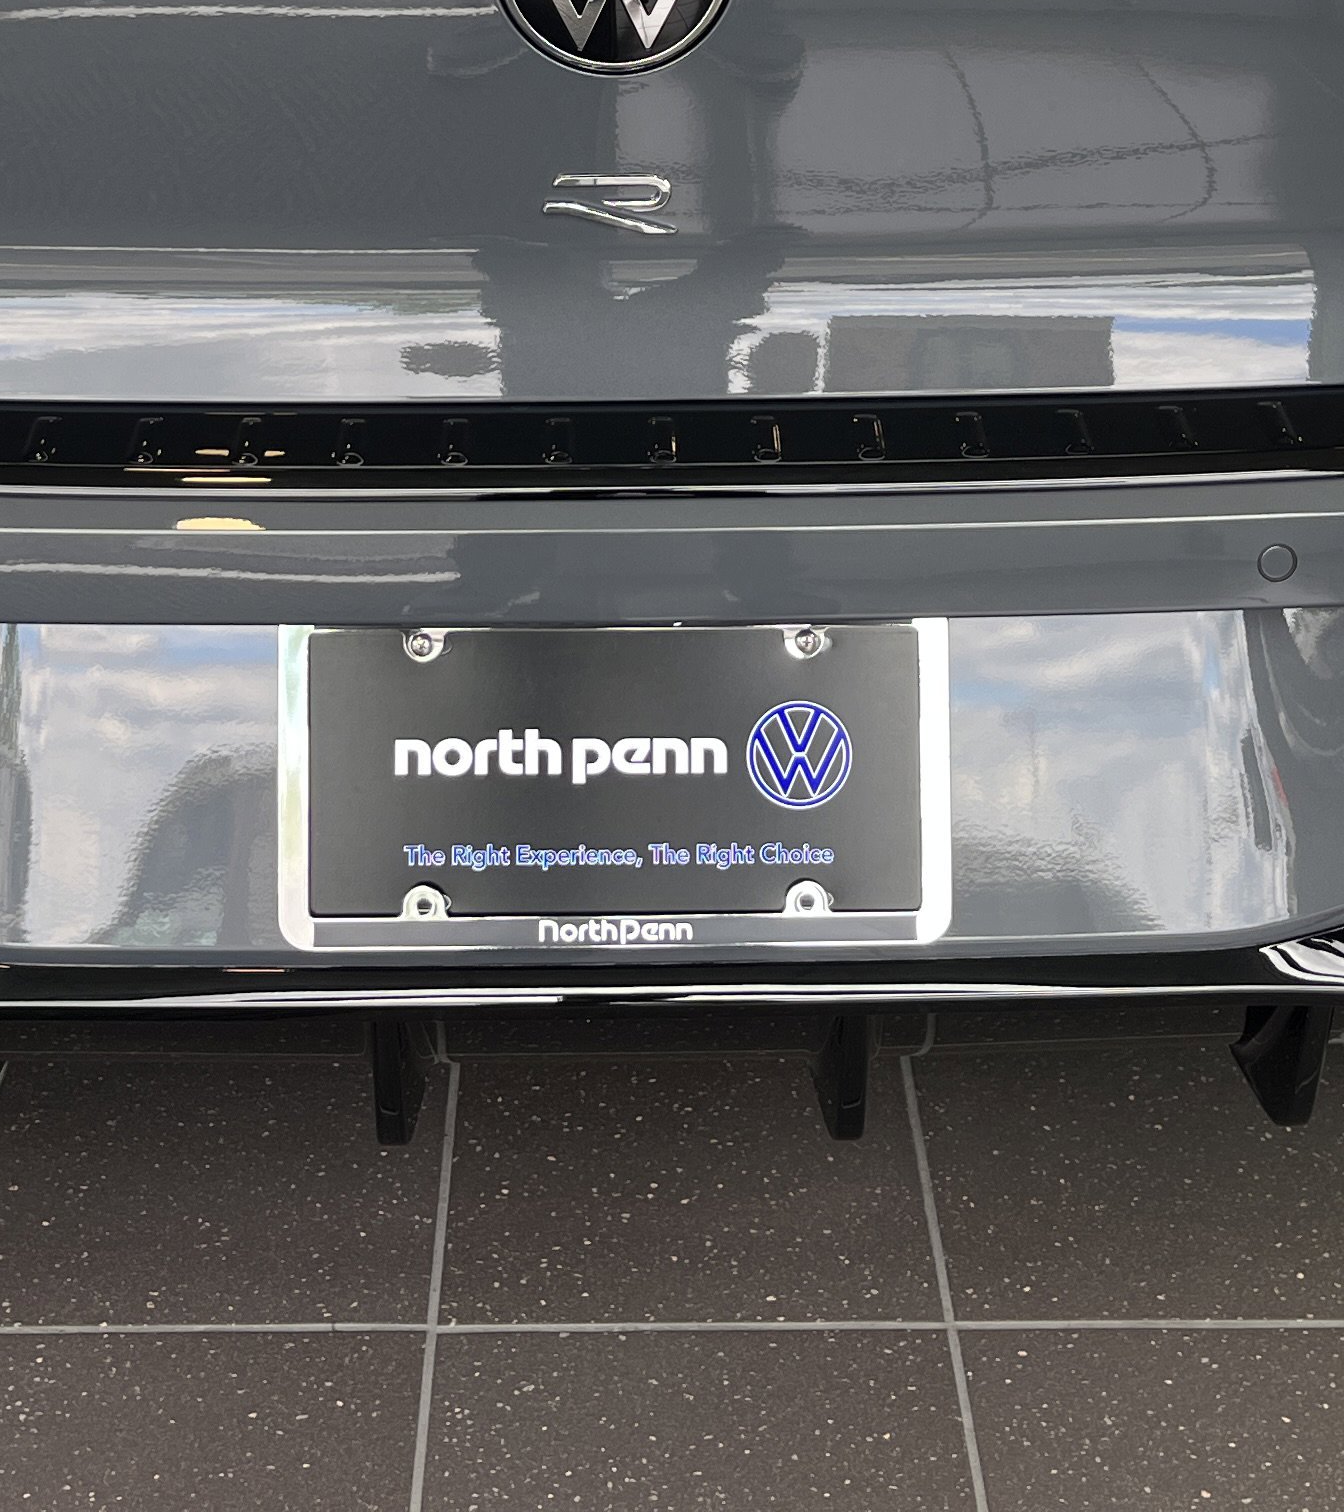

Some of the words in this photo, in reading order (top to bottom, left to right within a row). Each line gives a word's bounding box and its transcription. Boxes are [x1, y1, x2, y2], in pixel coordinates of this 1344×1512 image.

[542, 172, 679, 235] R
[393, 728, 562, 777] north
[571, 737, 728, 785] penn
[752, 704, 848, 804] VW
[403, 843, 445, 867] The
[451, 843, 511, 872] Right
[516, 844, 644, 872] Experience,
[648, 842, 691, 866] The
[696, 841, 755, 872] Right
[759, 841, 835, 865] Choice
